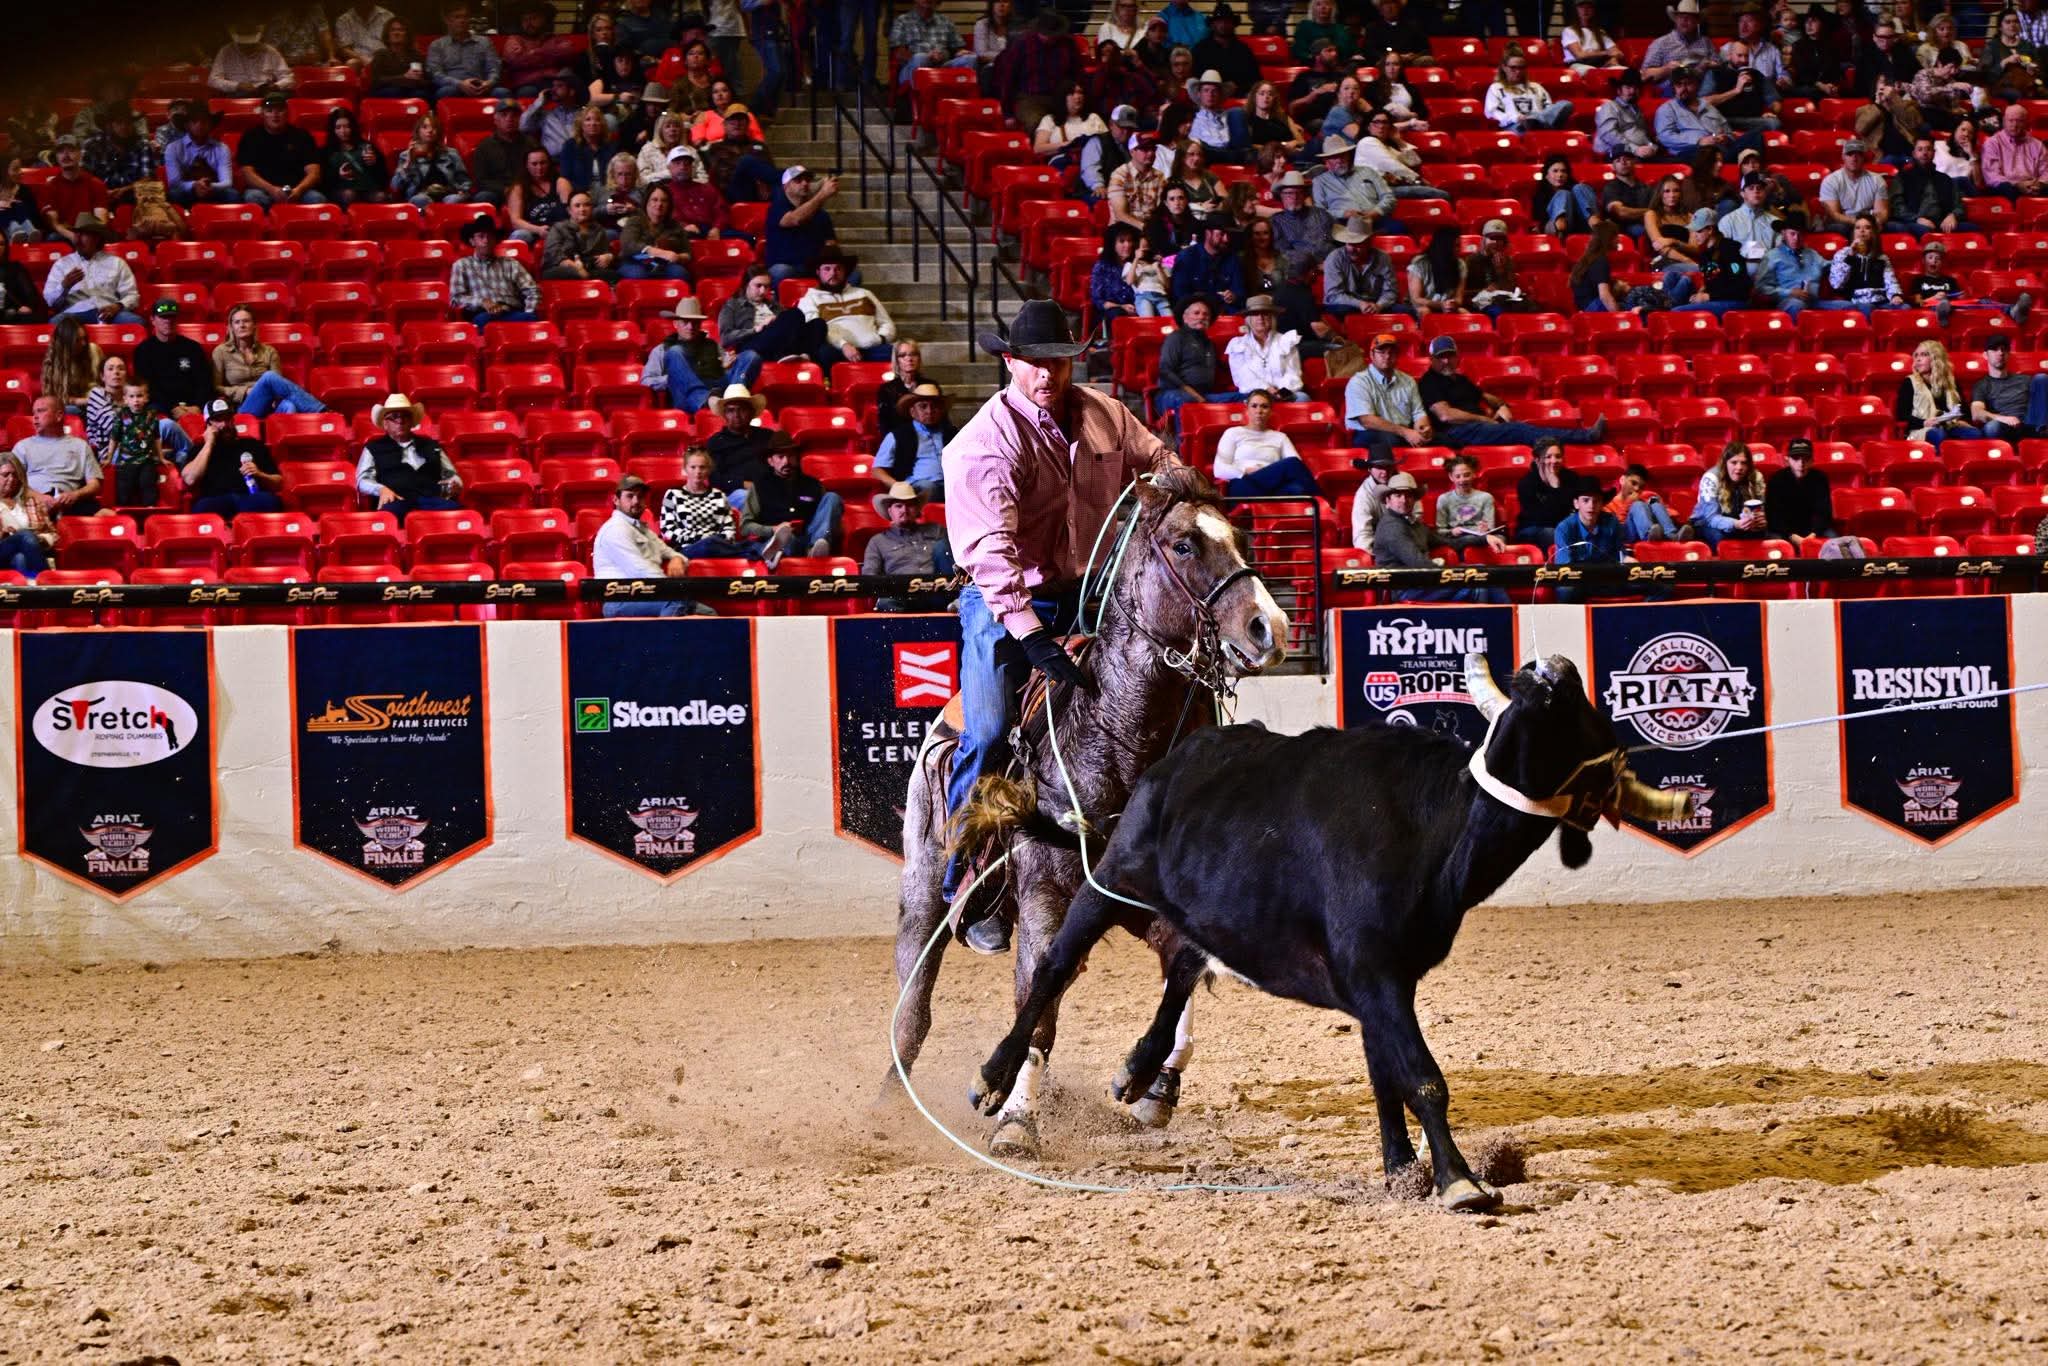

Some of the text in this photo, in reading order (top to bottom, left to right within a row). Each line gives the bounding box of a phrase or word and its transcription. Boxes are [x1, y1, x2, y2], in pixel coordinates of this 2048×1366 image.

[1642, 641, 1715, 665] STALLION
[1852, 665, 1998, 700] RESISTOL
[1370, 685, 1396, 702] US
[1619, 677, 1742, 709] RIATA
[53, 698, 168, 730] Stretch
[344, 690, 471, 732] Southwest
[612, 700, 747, 728] Standlee
[392, 719, 468, 728] FARM SERVICES
[1643, 716, 1719, 742] INCENTIVE
[1908, 767, 1951, 776] ARIAT
[1661, 774, 1704, 784] ARIAT
[640, 796, 687, 806] ARIAT
[368, 806, 416, 816] ARIAT
[1904, 809, 1958, 822] FINALE
[93, 814, 141, 823] ARIAT
[1657, 818, 1712, 830] FINALE
[635, 841, 695, 854] FINALE
[363, 852, 424, 864] FINALE
[88, 860, 149, 872] FINALE
